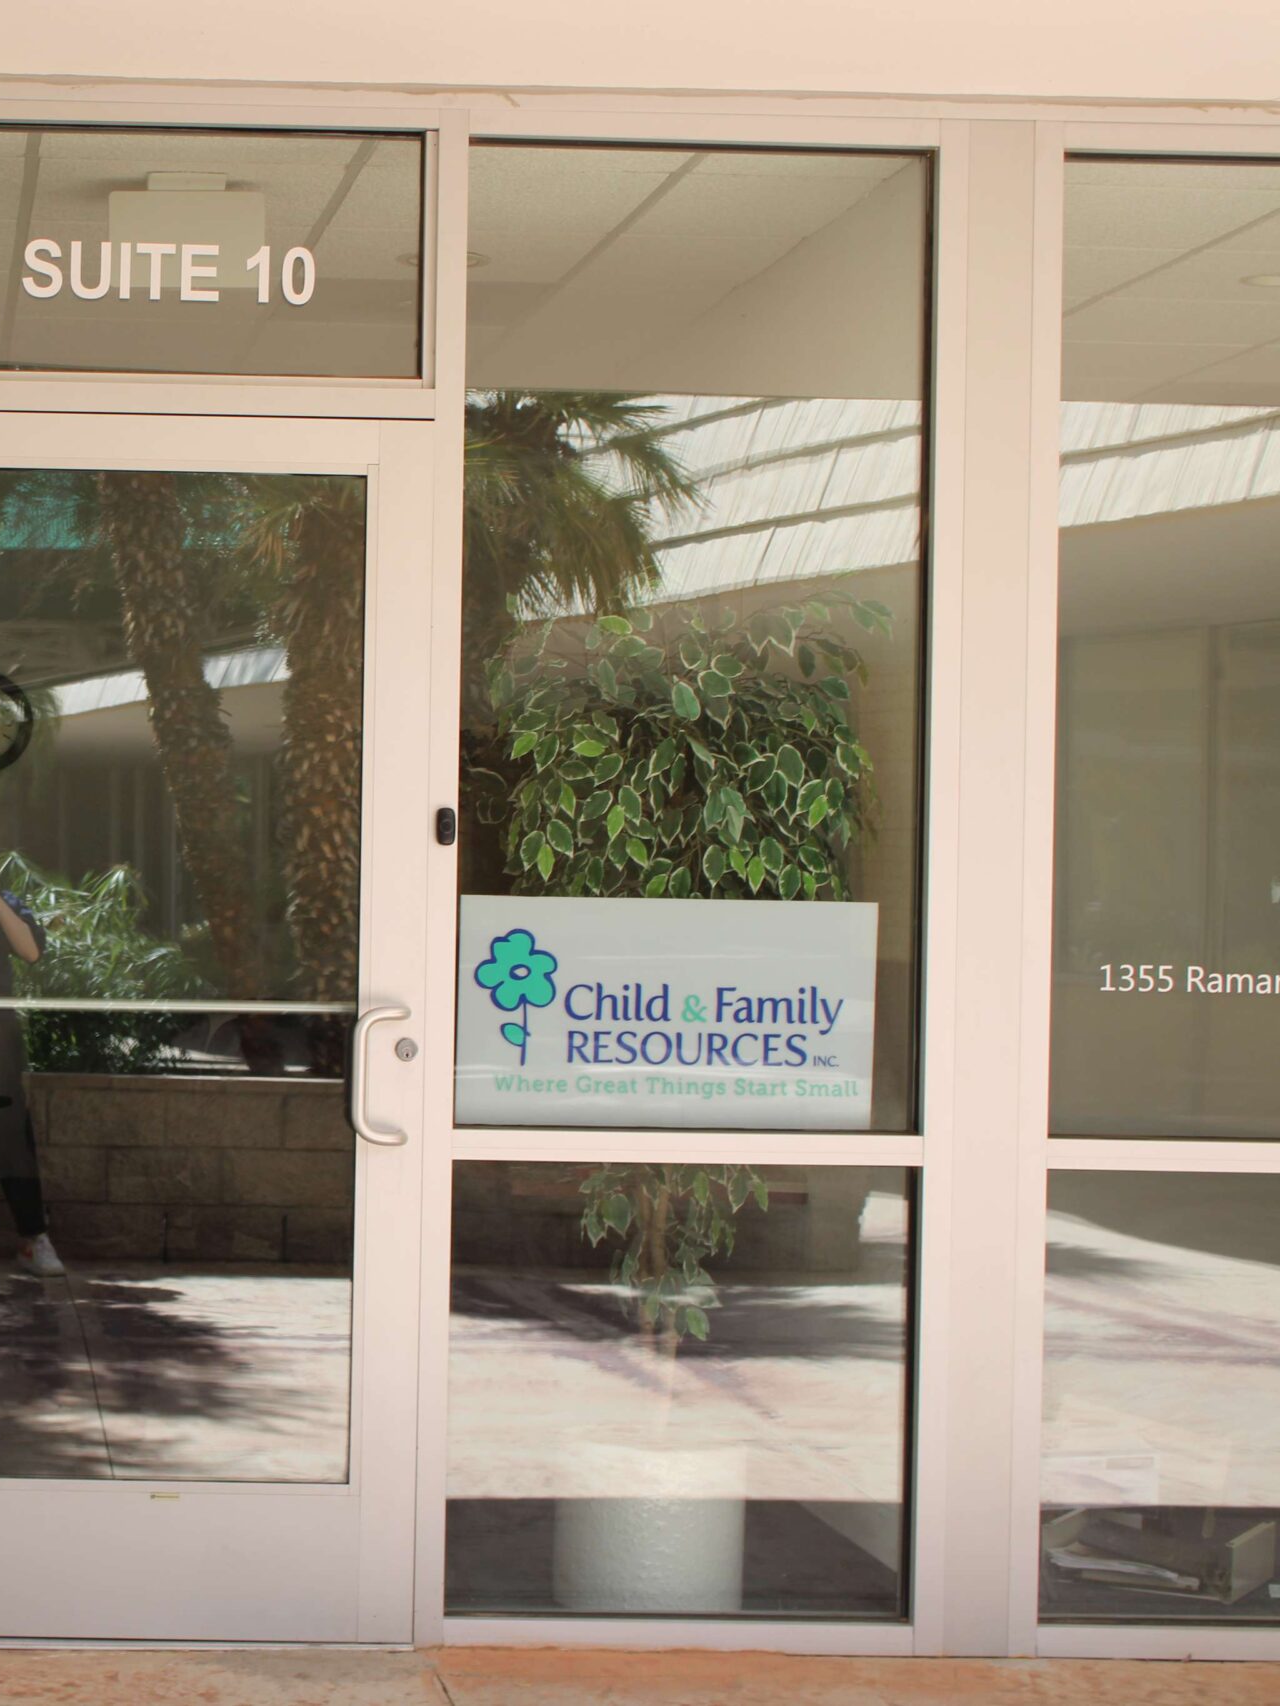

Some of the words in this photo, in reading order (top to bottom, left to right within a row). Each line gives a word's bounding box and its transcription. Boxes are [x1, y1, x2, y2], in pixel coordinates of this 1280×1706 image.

[22, 239, 220, 302] SUITE
[246, 246, 316, 305] 10
[1100, 964, 1174, 992] 1355
[564, 982, 671, 1022] Child
[680, 994, 708, 1024] &
[715, 986, 844, 1035] Family
[567, 1030, 808, 1067] RESOURCES
[494, 1073, 568, 1093] Where
[575, 1075, 638, 1094] Great
[646, 1076, 727, 1099] Things
[734, 1078, 788, 1096] Start
[794, 1079, 859, 1097] Small
